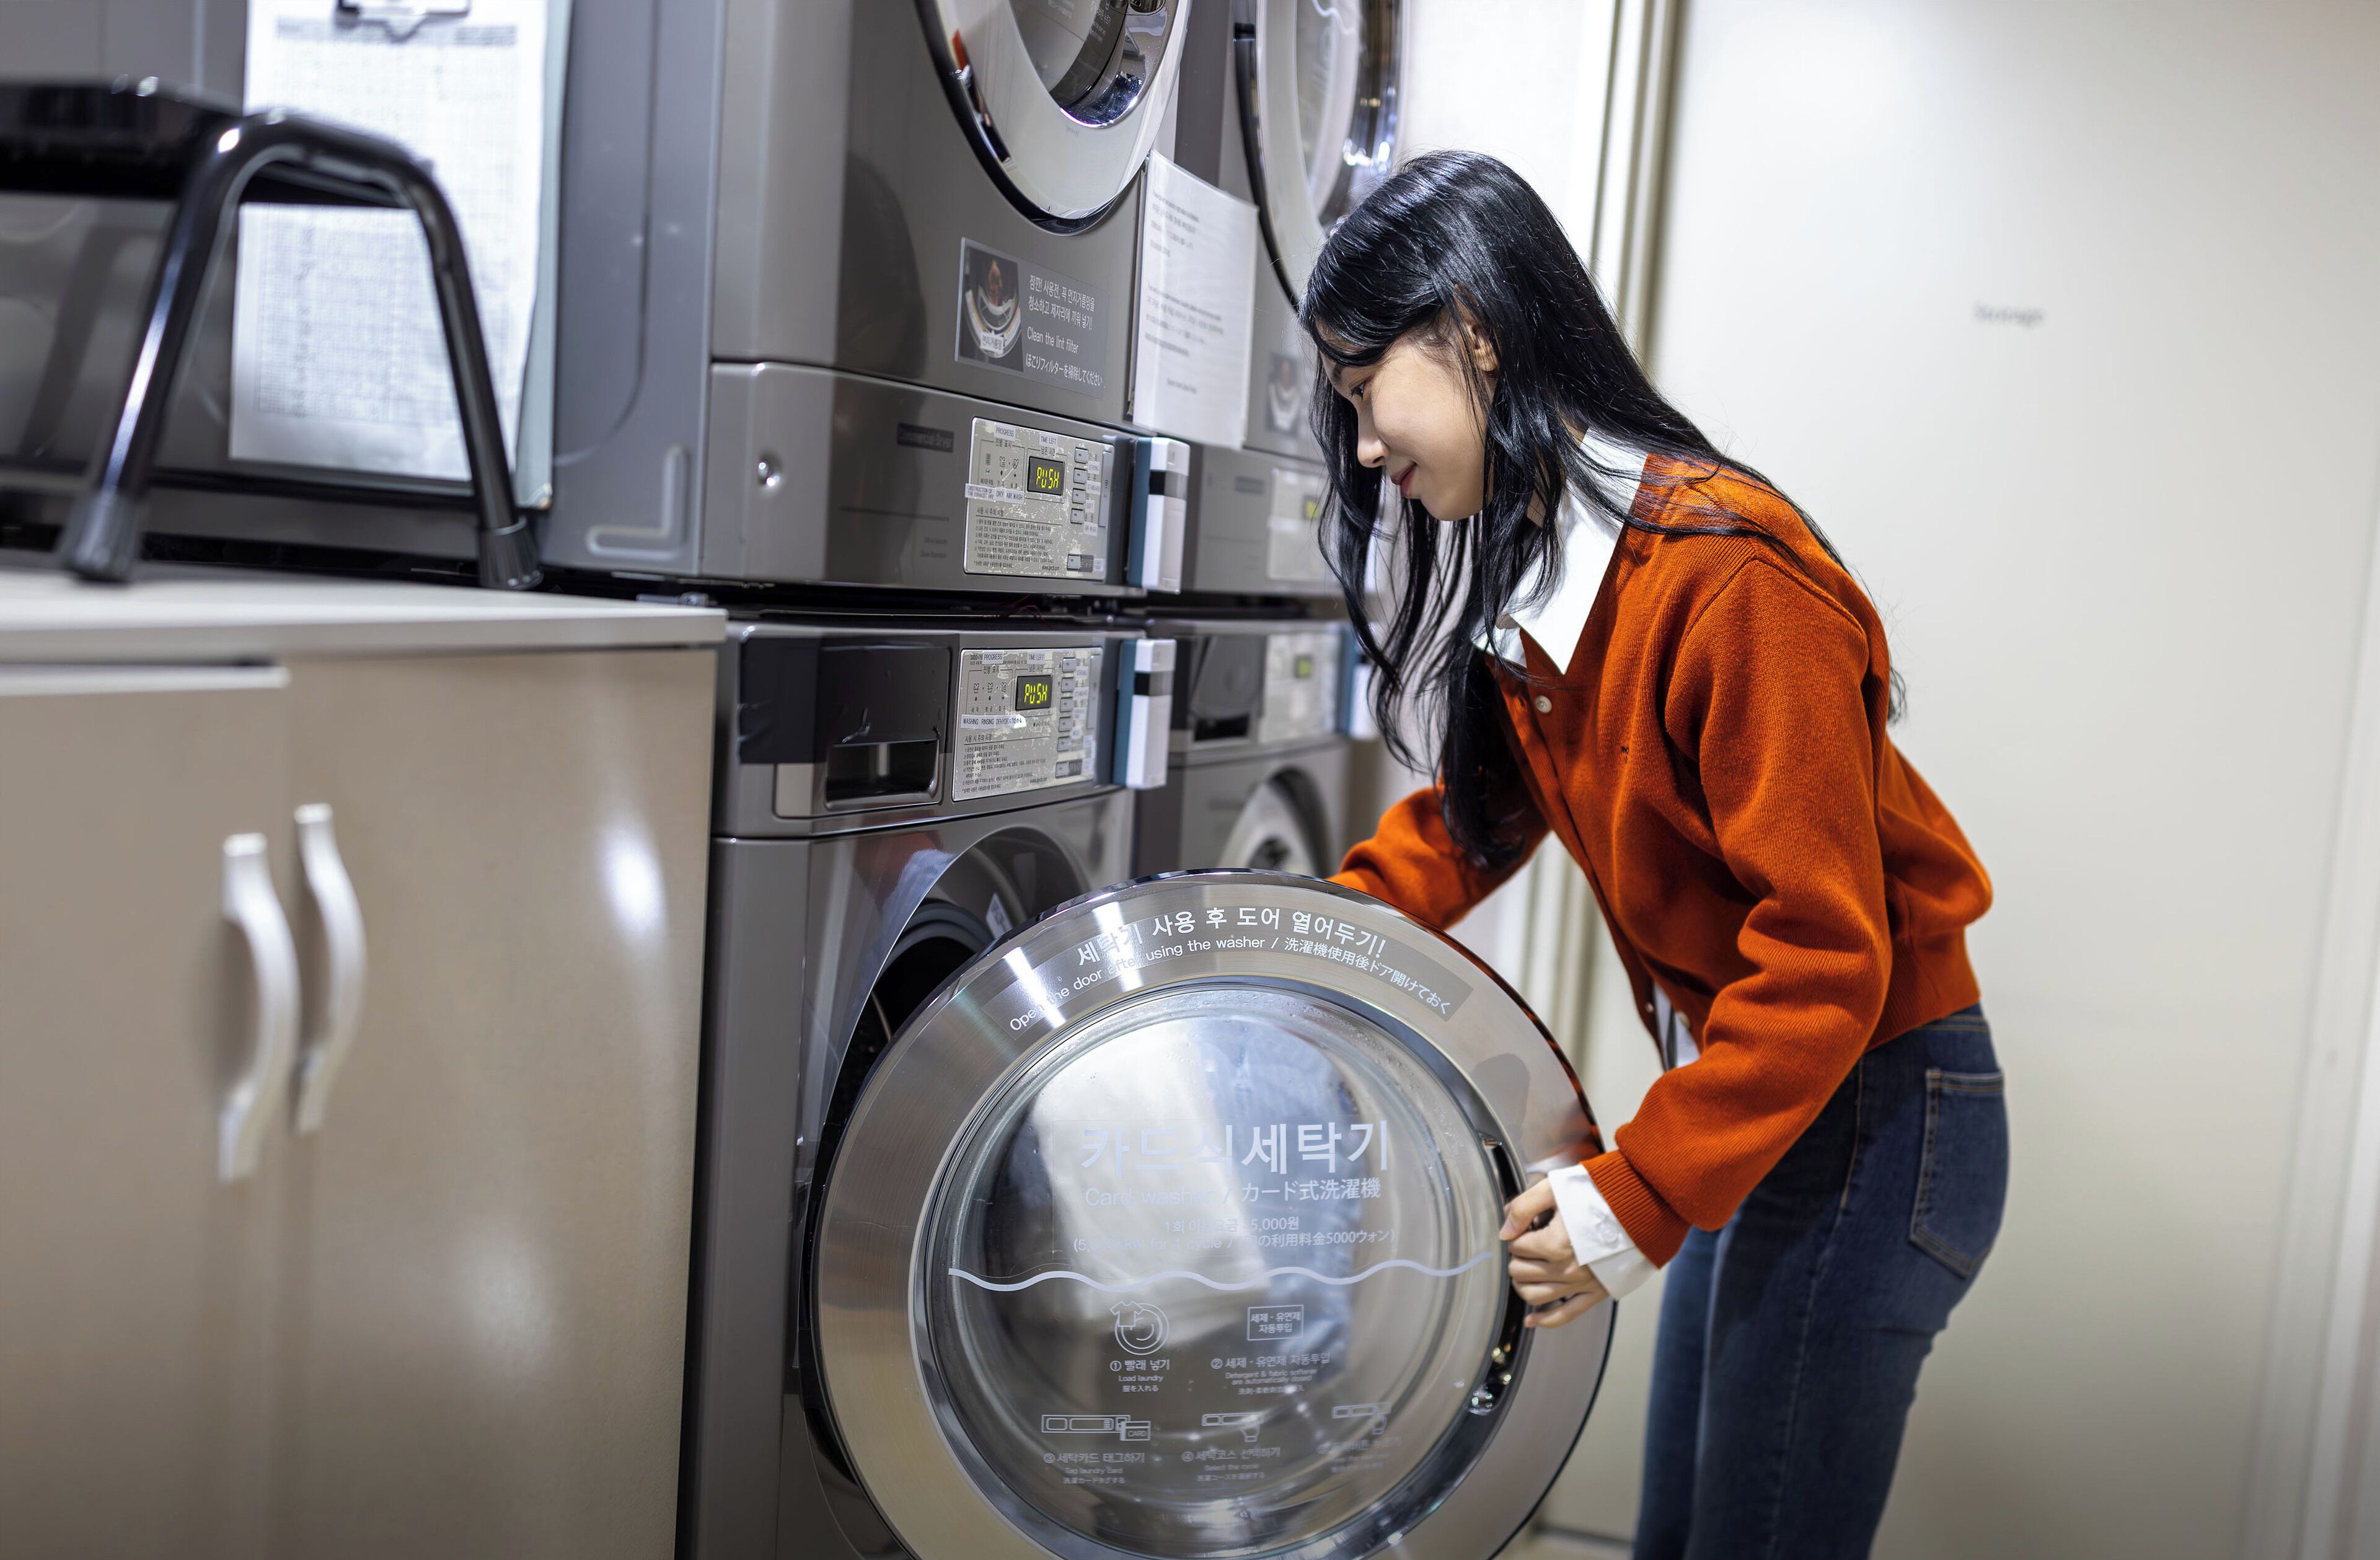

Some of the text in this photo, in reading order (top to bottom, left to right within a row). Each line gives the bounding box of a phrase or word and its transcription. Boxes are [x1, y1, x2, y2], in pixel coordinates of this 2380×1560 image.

[1029, 295, 1049, 314] 청소하고
[1051, 304, 1070, 322] 제자리에
[1061, 286, 1067, 302] 꼭
[1068, 289, 1095, 312] 먼지거름망을
[1027, 326, 1079, 353] Clean the lint filter
[995, 428, 1014, 438] PROGRESS
[1036, 467, 1059, 489] PUSH
[1024, 683, 1048, 705] PUSH
[1078, 907, 1386, 966] 세탁기 사용 후 도어 열어두기!
[1010, 1004, 1046, 1031] Open
[1073, 969, 1103, 990] door
[1108, 955, 1142, 975] afte
[1146, 944, 1183, 961] using
[1188, 940, 1211, 952] the
[1216, 936, 1266, 948] washer
[1284, 937, 1451, 1015] 洗濯機使用後ドア開けておく
[1081, 1120, 1388, 1178] 카드식세탁기
[1085, 1186, 1133, 1206] Card
[1141, 1185, 1215, 1205] washe
[1241, 1178, 1382, 1202] カード式洗濯機
[1166, 1220, 1185, 1233] 1회
[1186, 1238, 1222, 1251] cycle
[1240, 1229, 1395, 1248] の利用料金5000ウォン)
[1250, 1313, 1269, 1323] 세제
[1276, 1311, 1301, 1322] 유연제
[1259, 1323, 1293, 1334] 자동투입
[1125, 1359, 1147, 1372] 빨래
[1150, 1359, 1170, 1372] 넣기
[1225, 1357, 1247, 1368] 세제
[1256, 1355, 1287, 1367] 유연제
[1290, 1352, 1331, 1366] 자동투입
[1138, 1375, 1164, 1383] laundry
[1057, 1452, 1100, 1464] 세탁카드
[1103, 1452, 1145, 1463] 태그하기
[1196, 1449, 1238, 1461] 세탁코스
